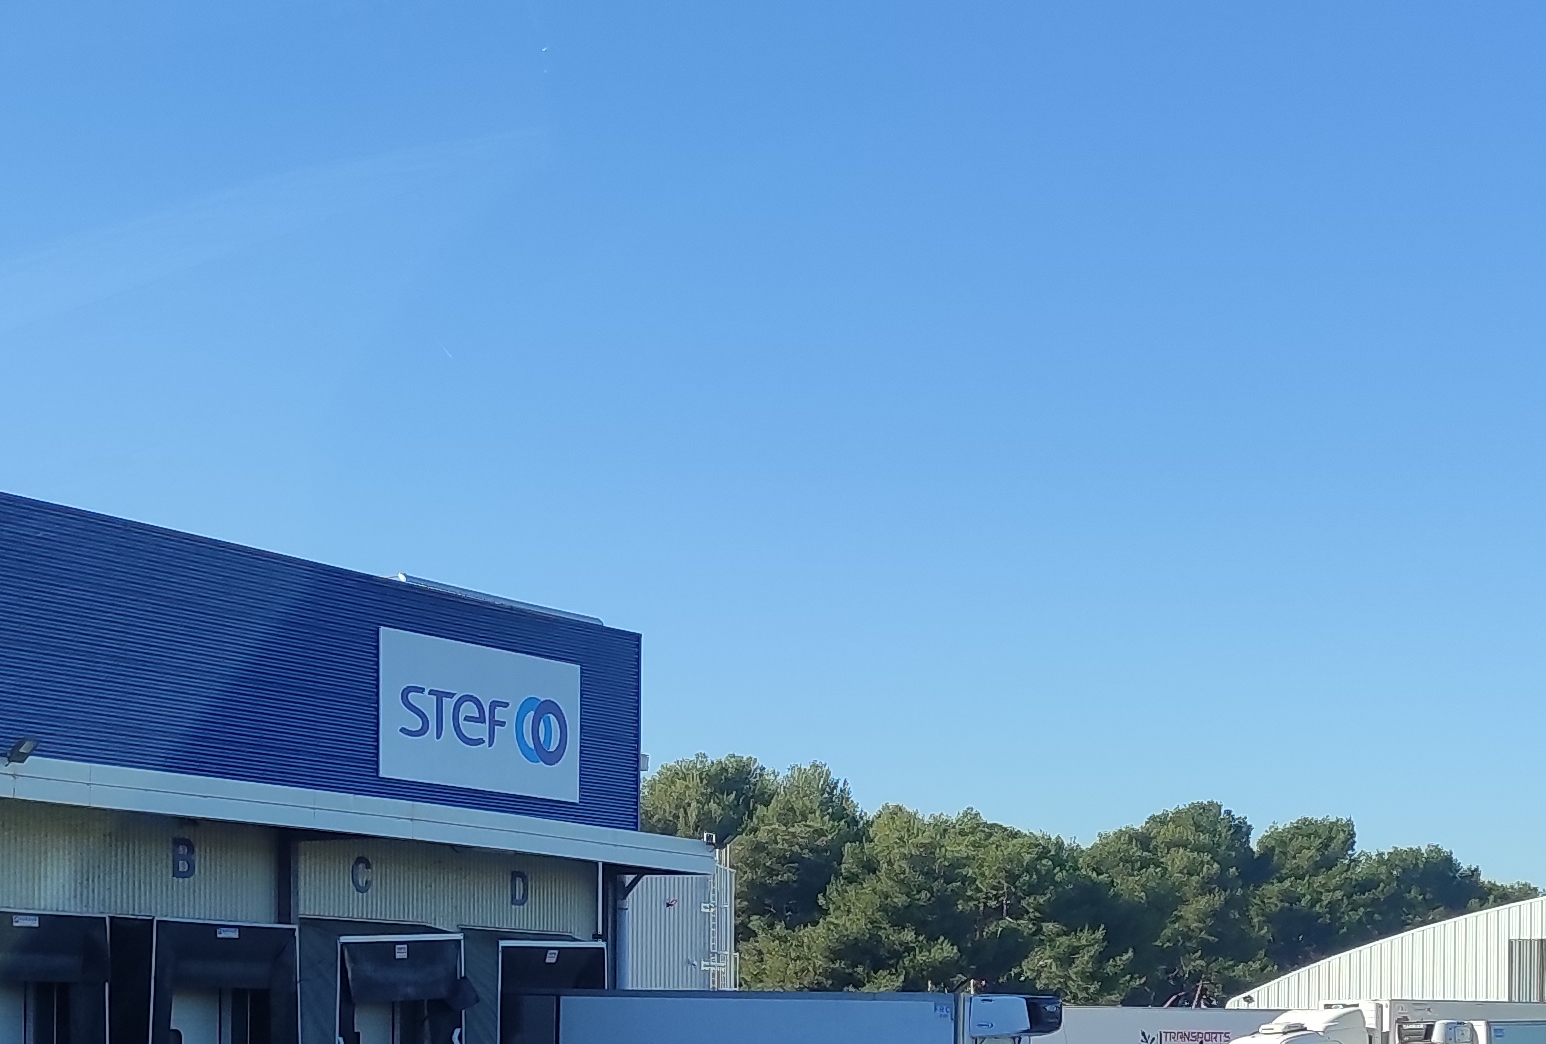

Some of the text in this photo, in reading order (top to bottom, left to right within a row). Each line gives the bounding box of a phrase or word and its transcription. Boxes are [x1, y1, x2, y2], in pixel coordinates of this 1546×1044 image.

[172, 837, 196, 878] B
[351, 856, 372, 893] C
[511, 870, 529, 906] D
[1162, 1031, 1231, 1042] TRANSPORTS
